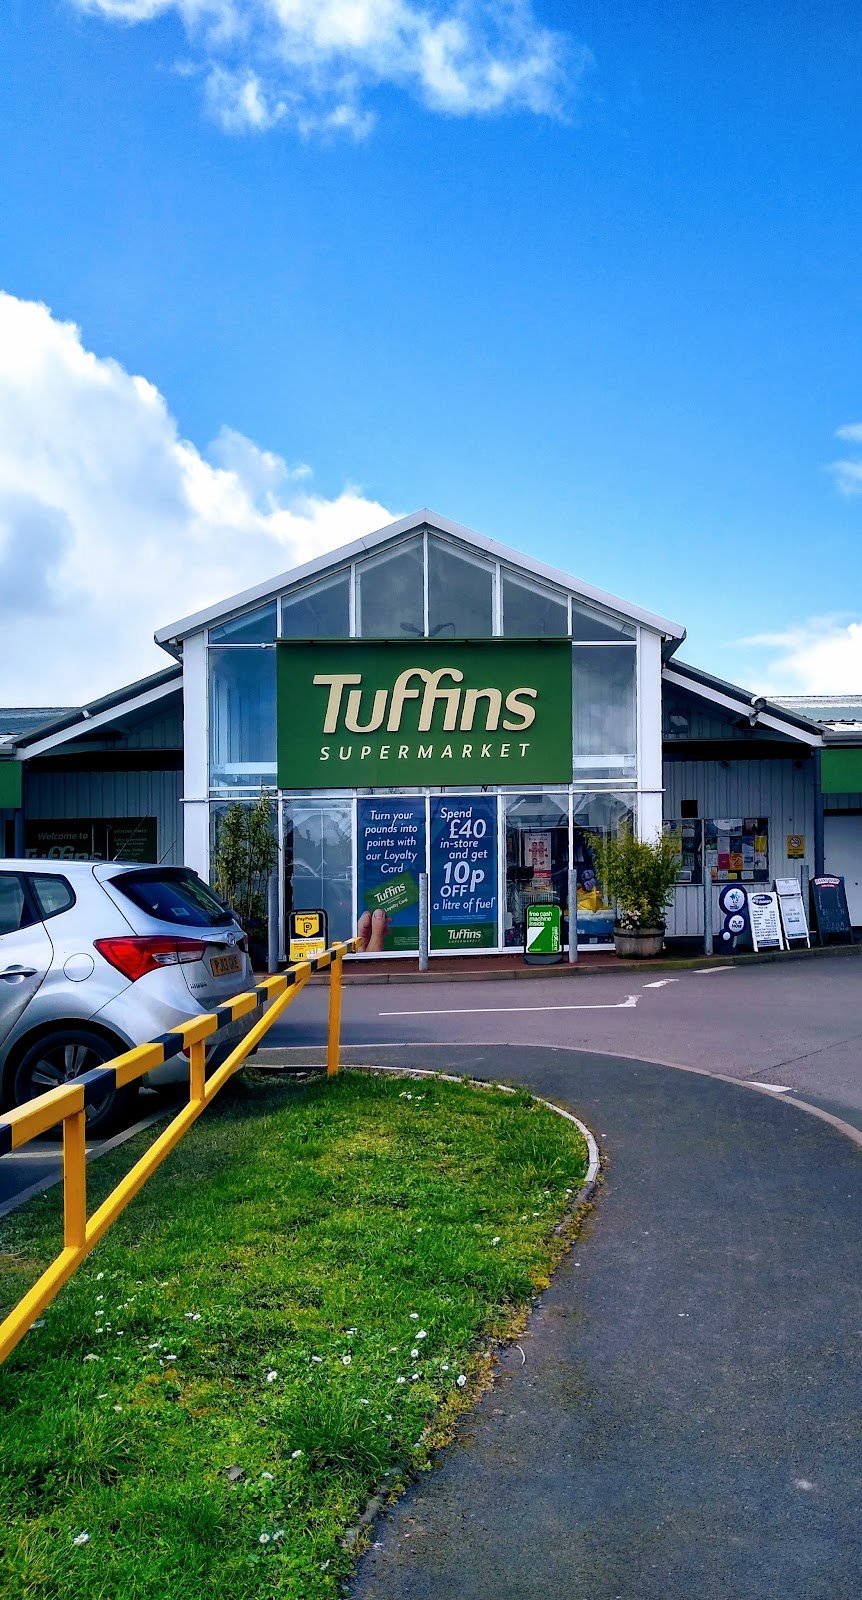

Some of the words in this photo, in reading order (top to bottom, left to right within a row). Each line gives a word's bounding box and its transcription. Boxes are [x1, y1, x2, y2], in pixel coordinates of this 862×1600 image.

[312, 667, 538, 734] Tuffins
[319, 743, 531, 761] SUPERMARKET
[370, 810, 390, 820] Turn
[392, 812, 414, 825] your
[440, 806, 473, 822] Spend
[364, 823, 397, 837] pounds
[400, 823, 418, 833] into
[449, 818, 487, 838] £40
[38, 832, 77, 841] Welcome
[78, 832, 89, 840] to
[366, 837, 395, 850] points
[397, 836, 416, 846] with
[440, 837, 479, 848] in-store
[365, 853, 381, 861] our
[384, 849, 418, 863] Loyalty
[448, 848, 468, 859] and
[471, 850, 488, 862] get
[380, 862, 404, 873] Card
[443, 861, 485, 892] 10p
[373, 883, 406, 902] Tuffins
[440, 884, 468, 897] OFF
[442, 898, 460, 910] litre
[463, 897, 474, 913] of
[447, 928, 482, 940] Tuffins
